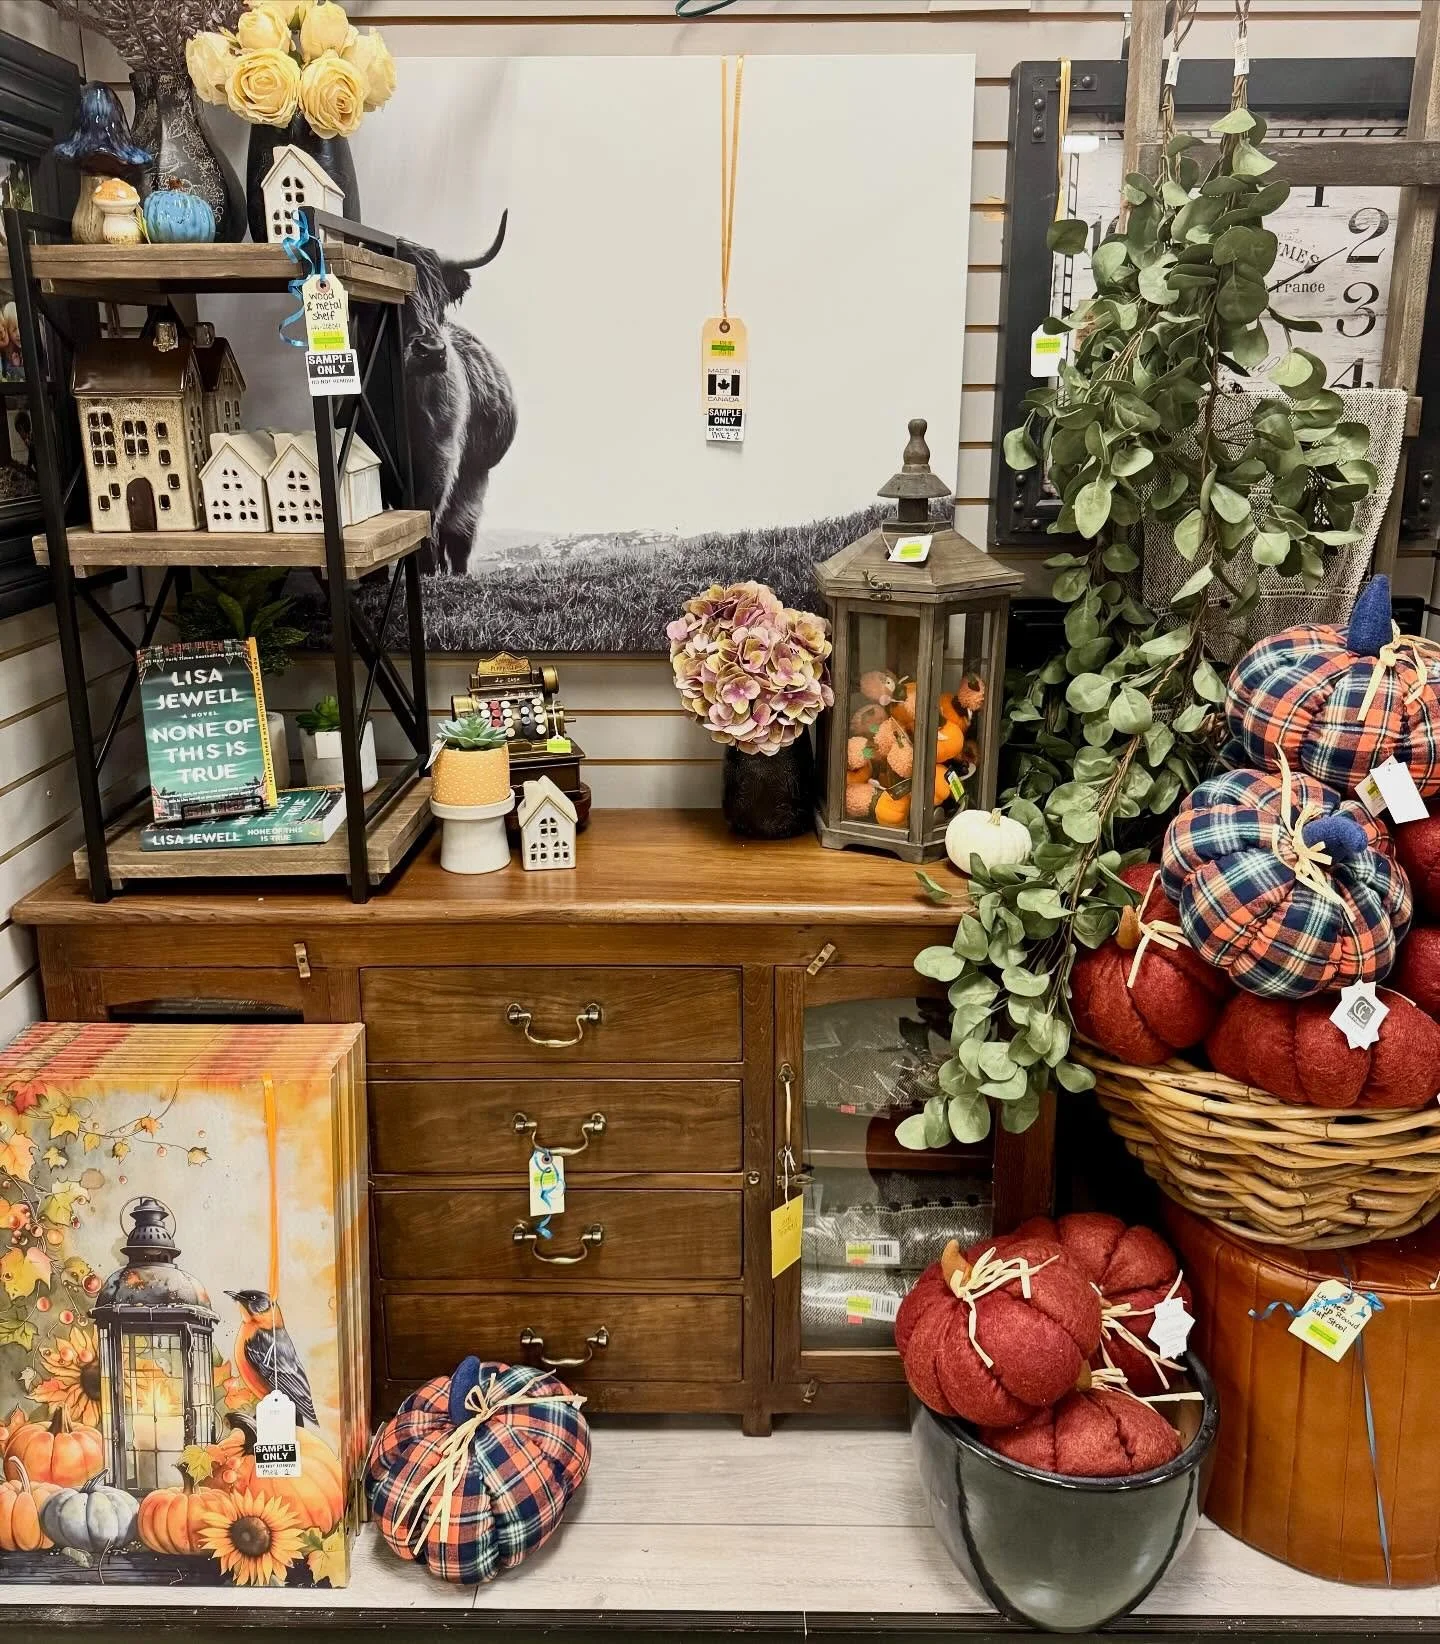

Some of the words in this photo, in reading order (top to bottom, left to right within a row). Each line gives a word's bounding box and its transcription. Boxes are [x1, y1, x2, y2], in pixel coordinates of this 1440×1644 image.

[1347, 207, 1389, 264] 2
[1276, 279, 1325, 293] France
[309, 289, 335, 300] wood
[316, 299, 342, 311] metal
[1336, 281, 1380, 338] 3
[312, 310, 336, 321] shelf
[308, 354, 353, 365] SAMPLE
[317, 364, 346, 375] ONLY
[708, 408, 742, 417] SAMPLE
[714, 416, 736, 425] ONLY
[171, 667, 223, 686] LISA
[157, 688, 245, 710] JEWELL
[191, 710, 219, 718] NOVEL
[152, 722, 224, 743] NONE
[224, 718, 256, 735] OF
[167, 743, 222, 763] THIS
[225, 740, 248, 757] IS
[176, 763, 240, 784] TRUE
[247, 828, 271, 836] NONE
[271, 827, 282, 836] OF
[282, 826, 303, 834] THIS
[152, 835, 184, 846] LISA
[186, 831, 241, 845] JEWELL
[255, 1444, 295, 1453] SAMPLE
[262, 1452, 289, 1461] ONLY
